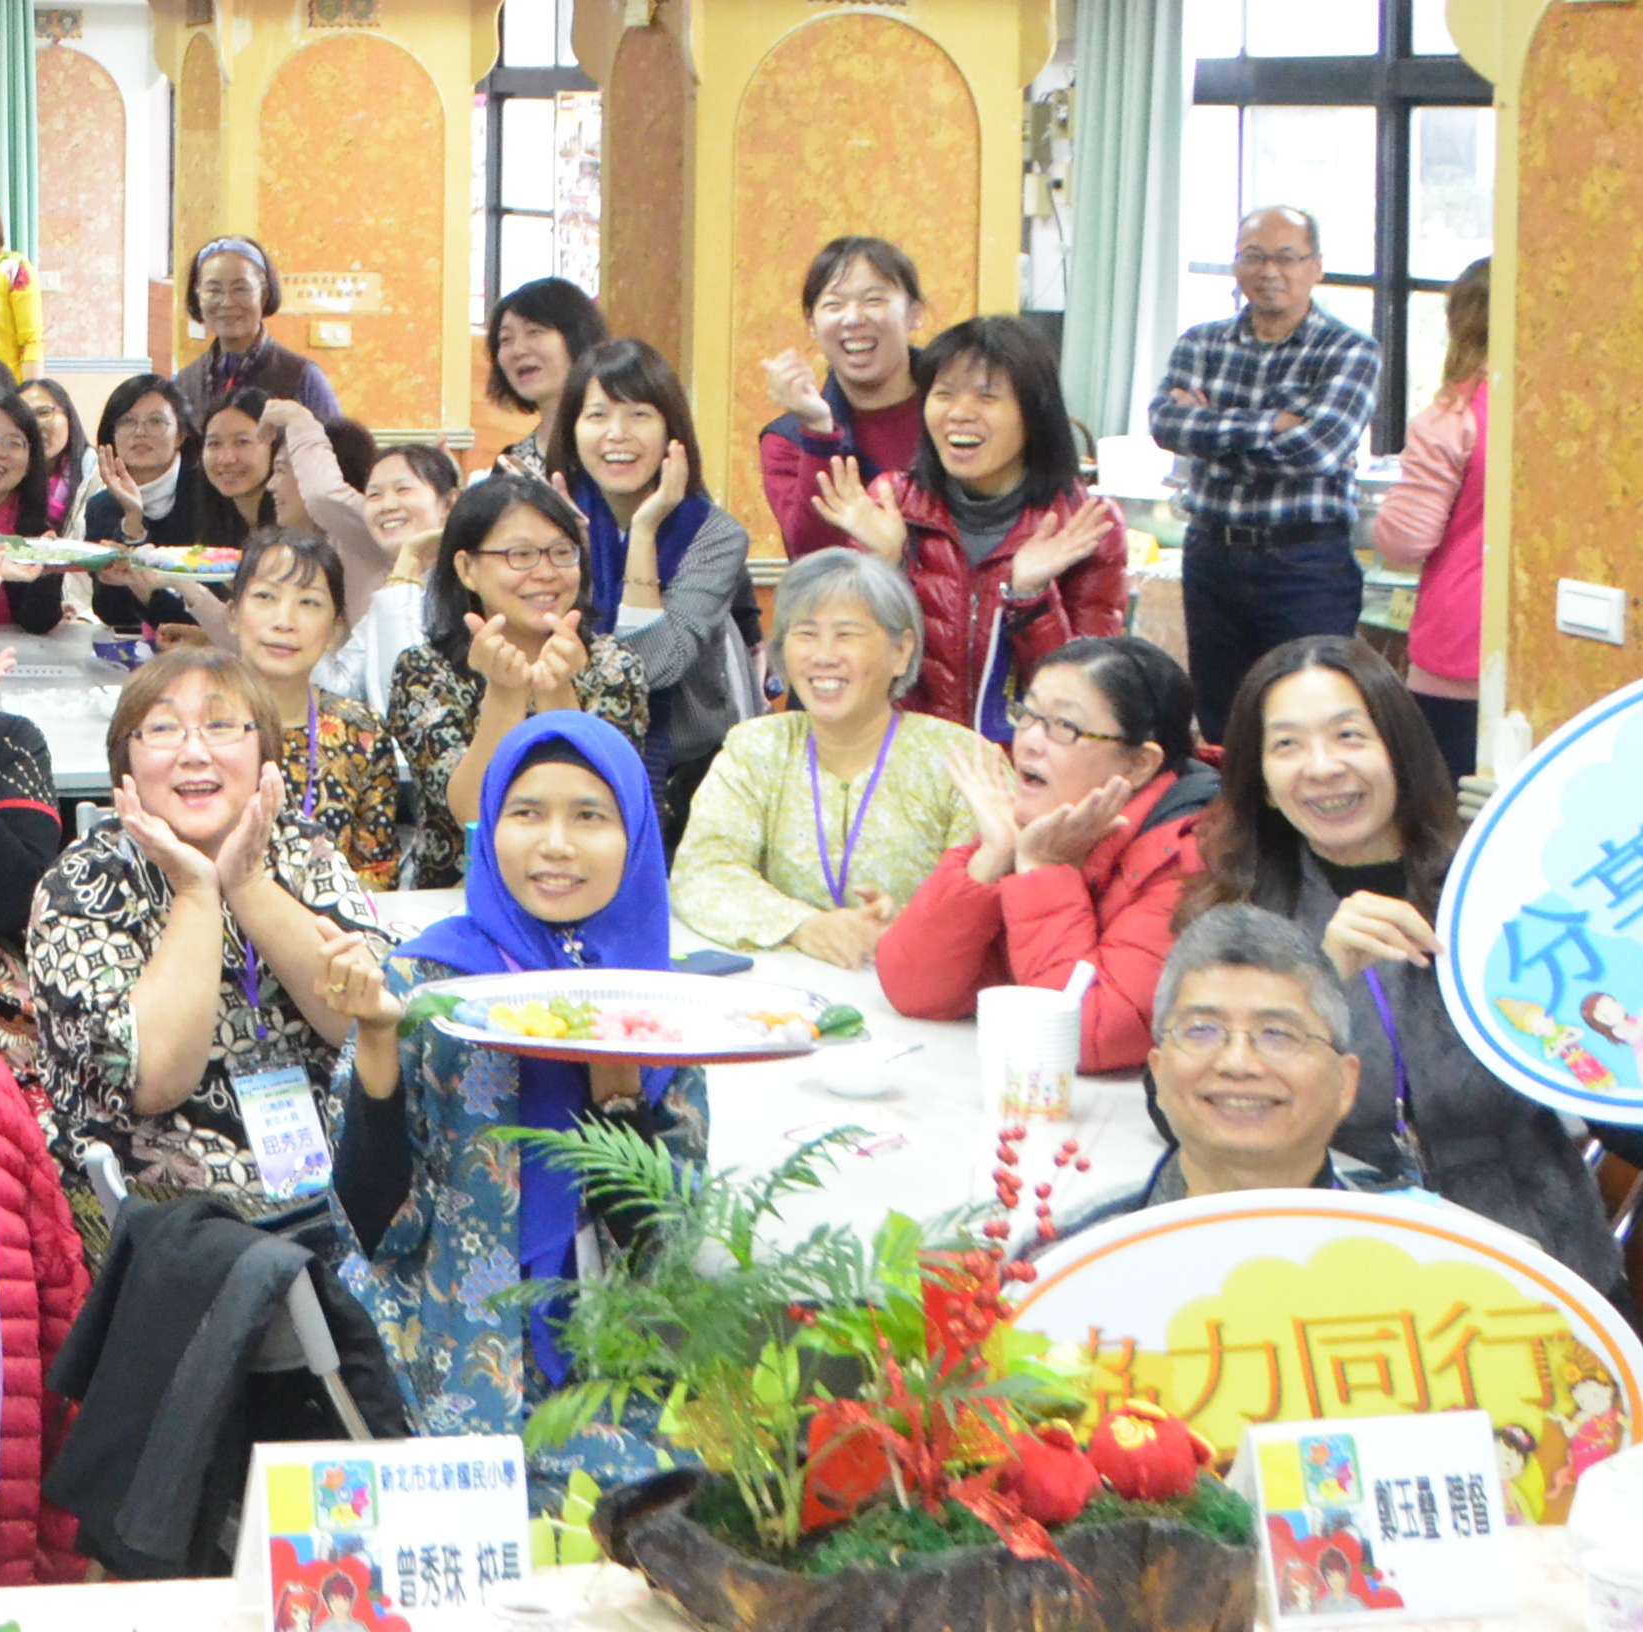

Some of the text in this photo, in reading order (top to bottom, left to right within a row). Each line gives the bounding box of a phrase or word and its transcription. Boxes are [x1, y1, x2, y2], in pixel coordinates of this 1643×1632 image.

[380, 1459, 517, 1492] 新北市北新國民小學
[397, 1542, 468, 1608] 曾秀珠
